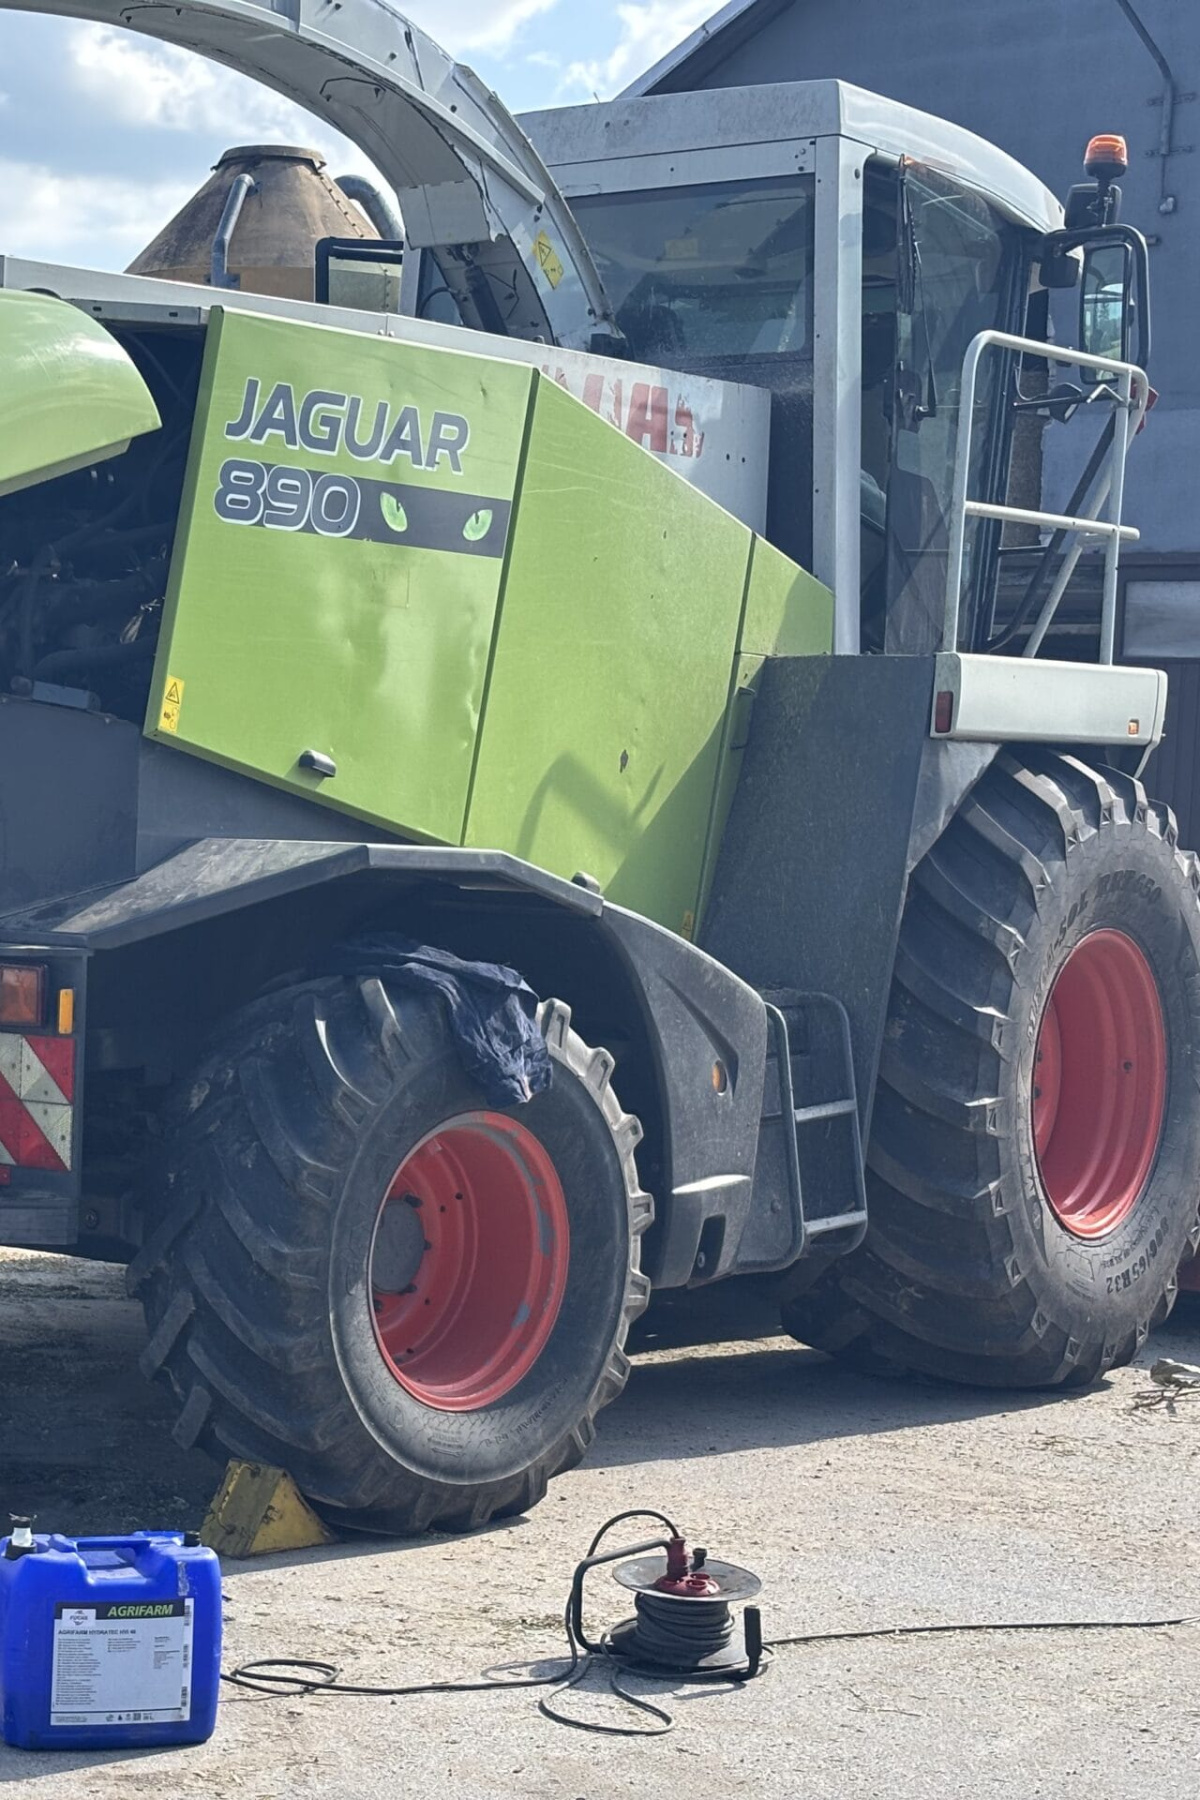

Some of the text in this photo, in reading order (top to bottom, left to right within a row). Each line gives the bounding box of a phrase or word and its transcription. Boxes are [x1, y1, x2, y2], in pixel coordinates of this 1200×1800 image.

[224, 376, 470, 476] JAGUAR
[213, 457, 361, 538] 890
[107, 1604, 174, 1618] AGRIFARM
